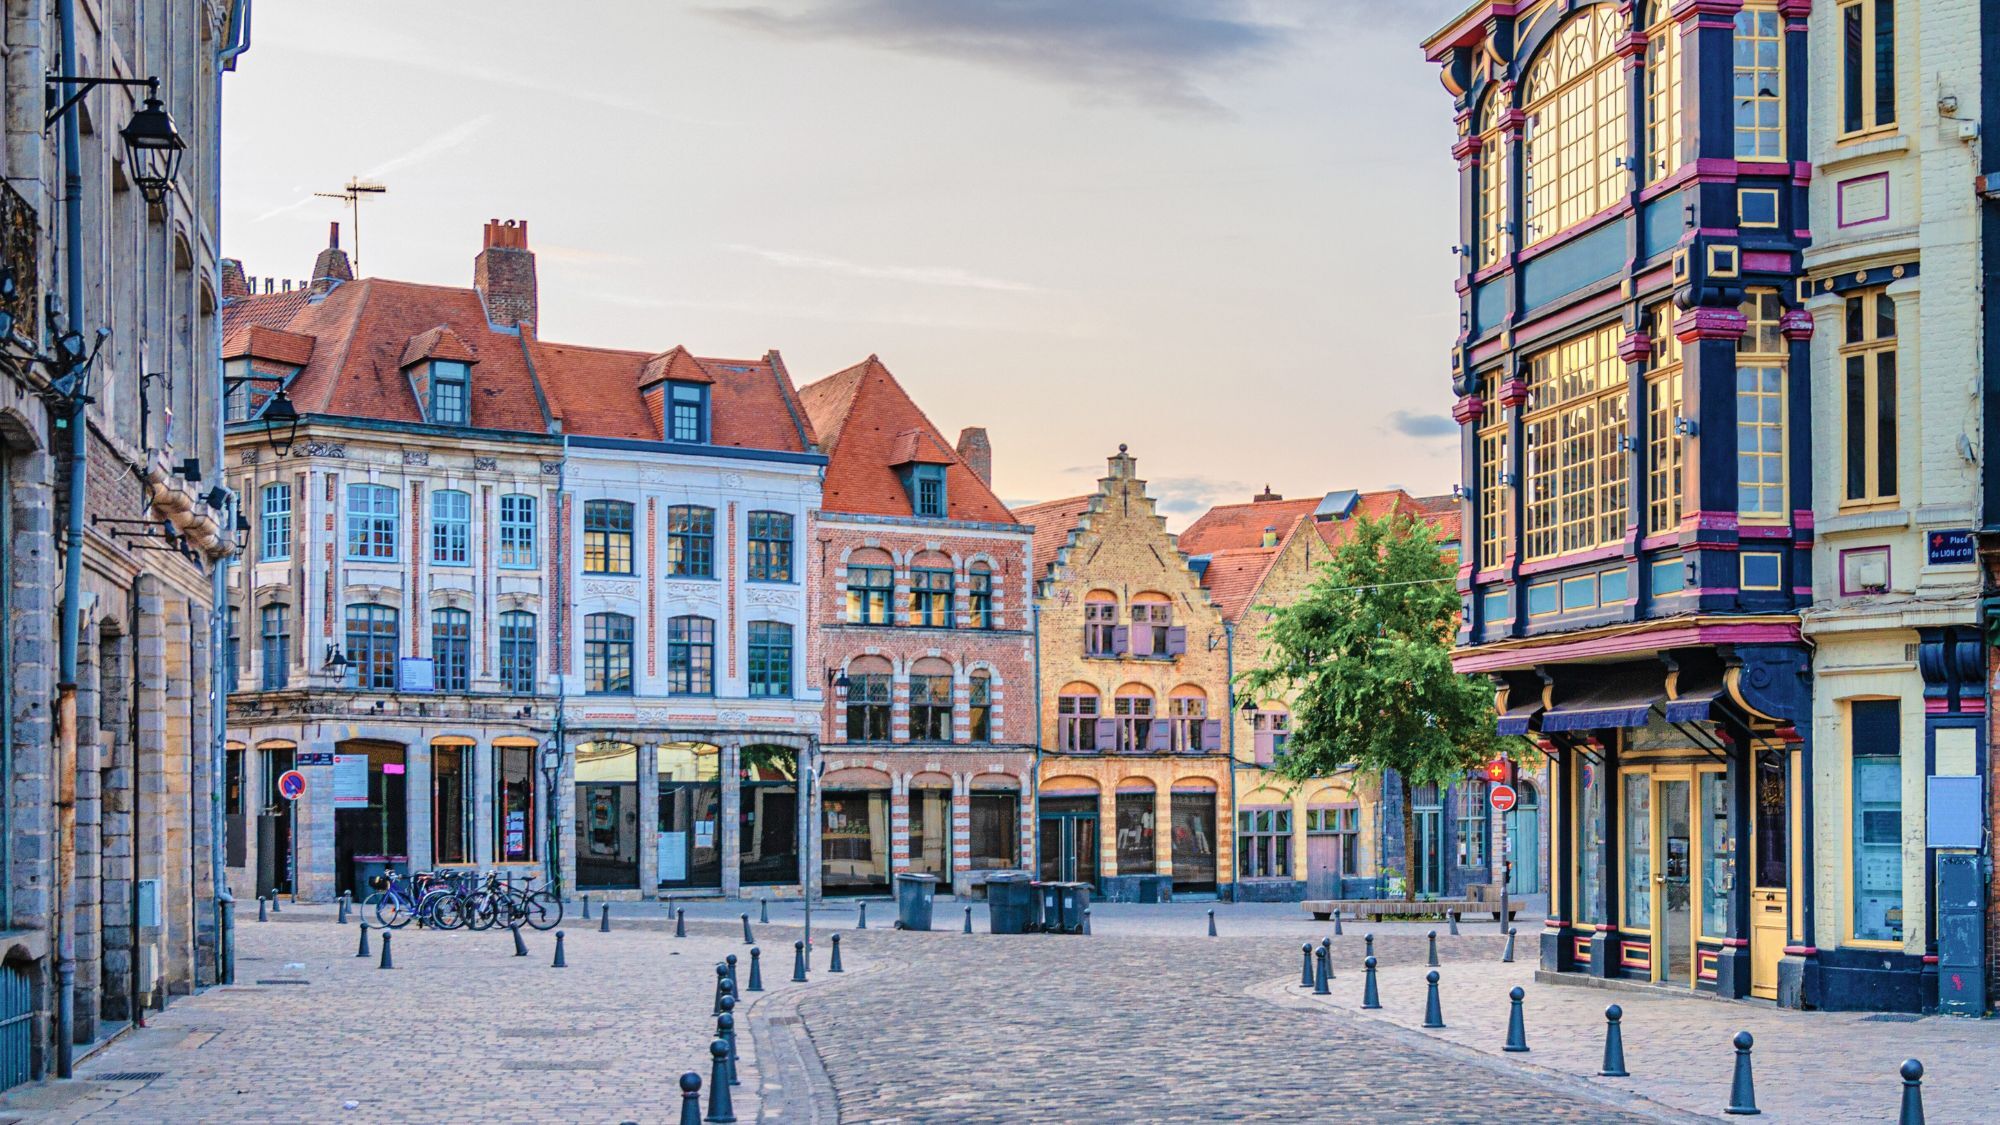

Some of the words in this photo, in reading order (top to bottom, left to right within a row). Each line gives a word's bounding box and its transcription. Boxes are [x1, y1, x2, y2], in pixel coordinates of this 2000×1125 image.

[1950, 536, 1968, 544] Place
[1931, 550, 1939, 558] du
[1940, 549, 1955, 557] LION
